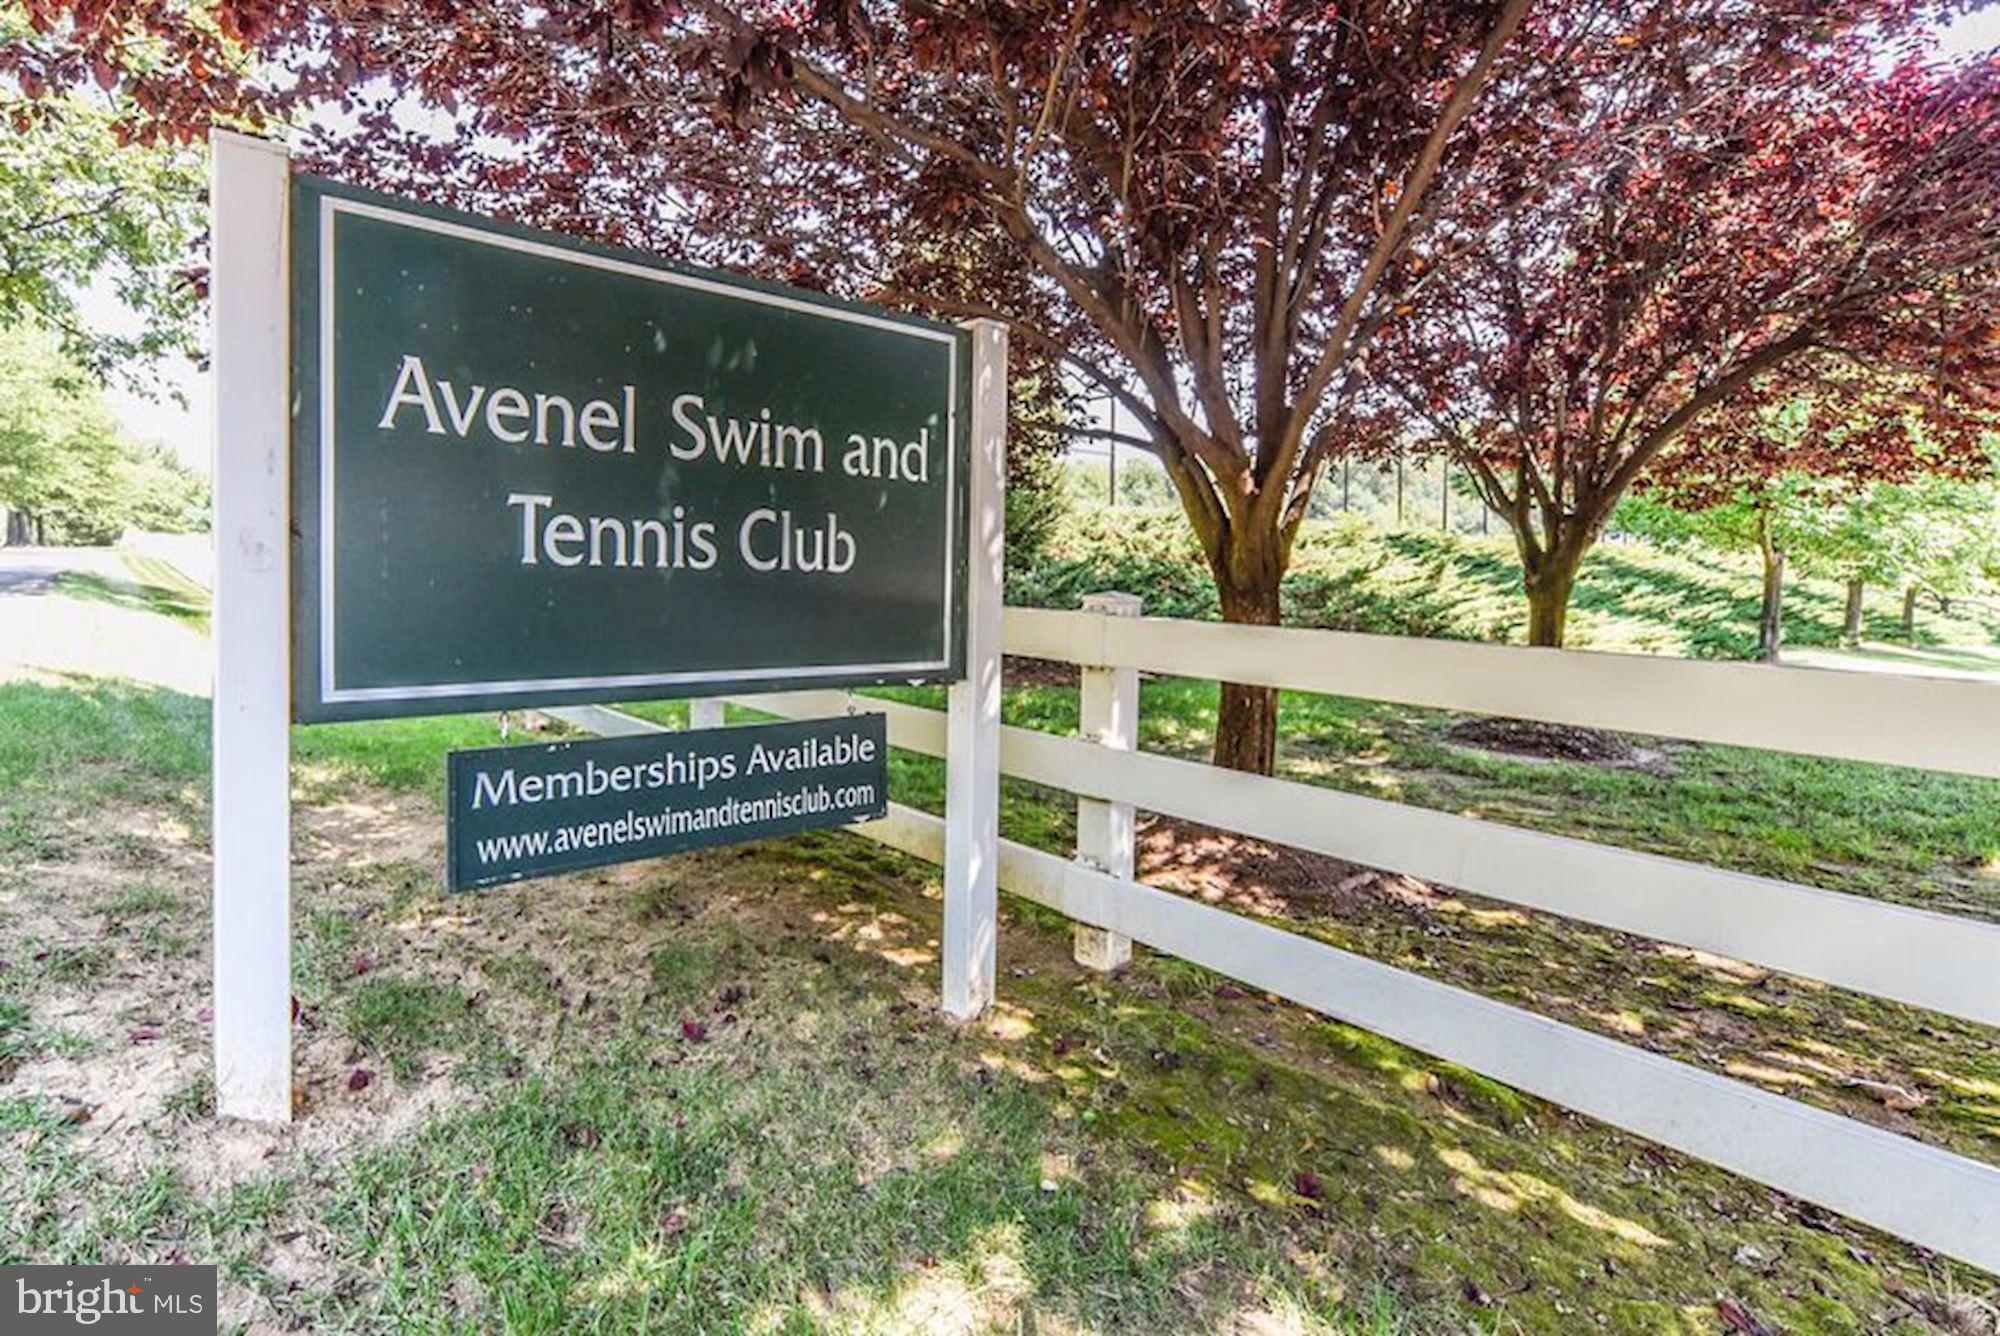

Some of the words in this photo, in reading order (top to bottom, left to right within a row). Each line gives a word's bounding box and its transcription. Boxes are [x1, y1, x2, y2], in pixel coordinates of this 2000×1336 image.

[378, 354, 635, 453] Avenel
[669, 394, 824, 473] Swim
[842, 428, 929, 483] and
[507, 493, 717, 570] Tennis
[740, 509, 856, 573] Club
[471, 751, 737, 810] Memberships
[745, 733, 876, 776] Available
[476, 783, 875, 865] www.avenelswimandtennisclub.com
